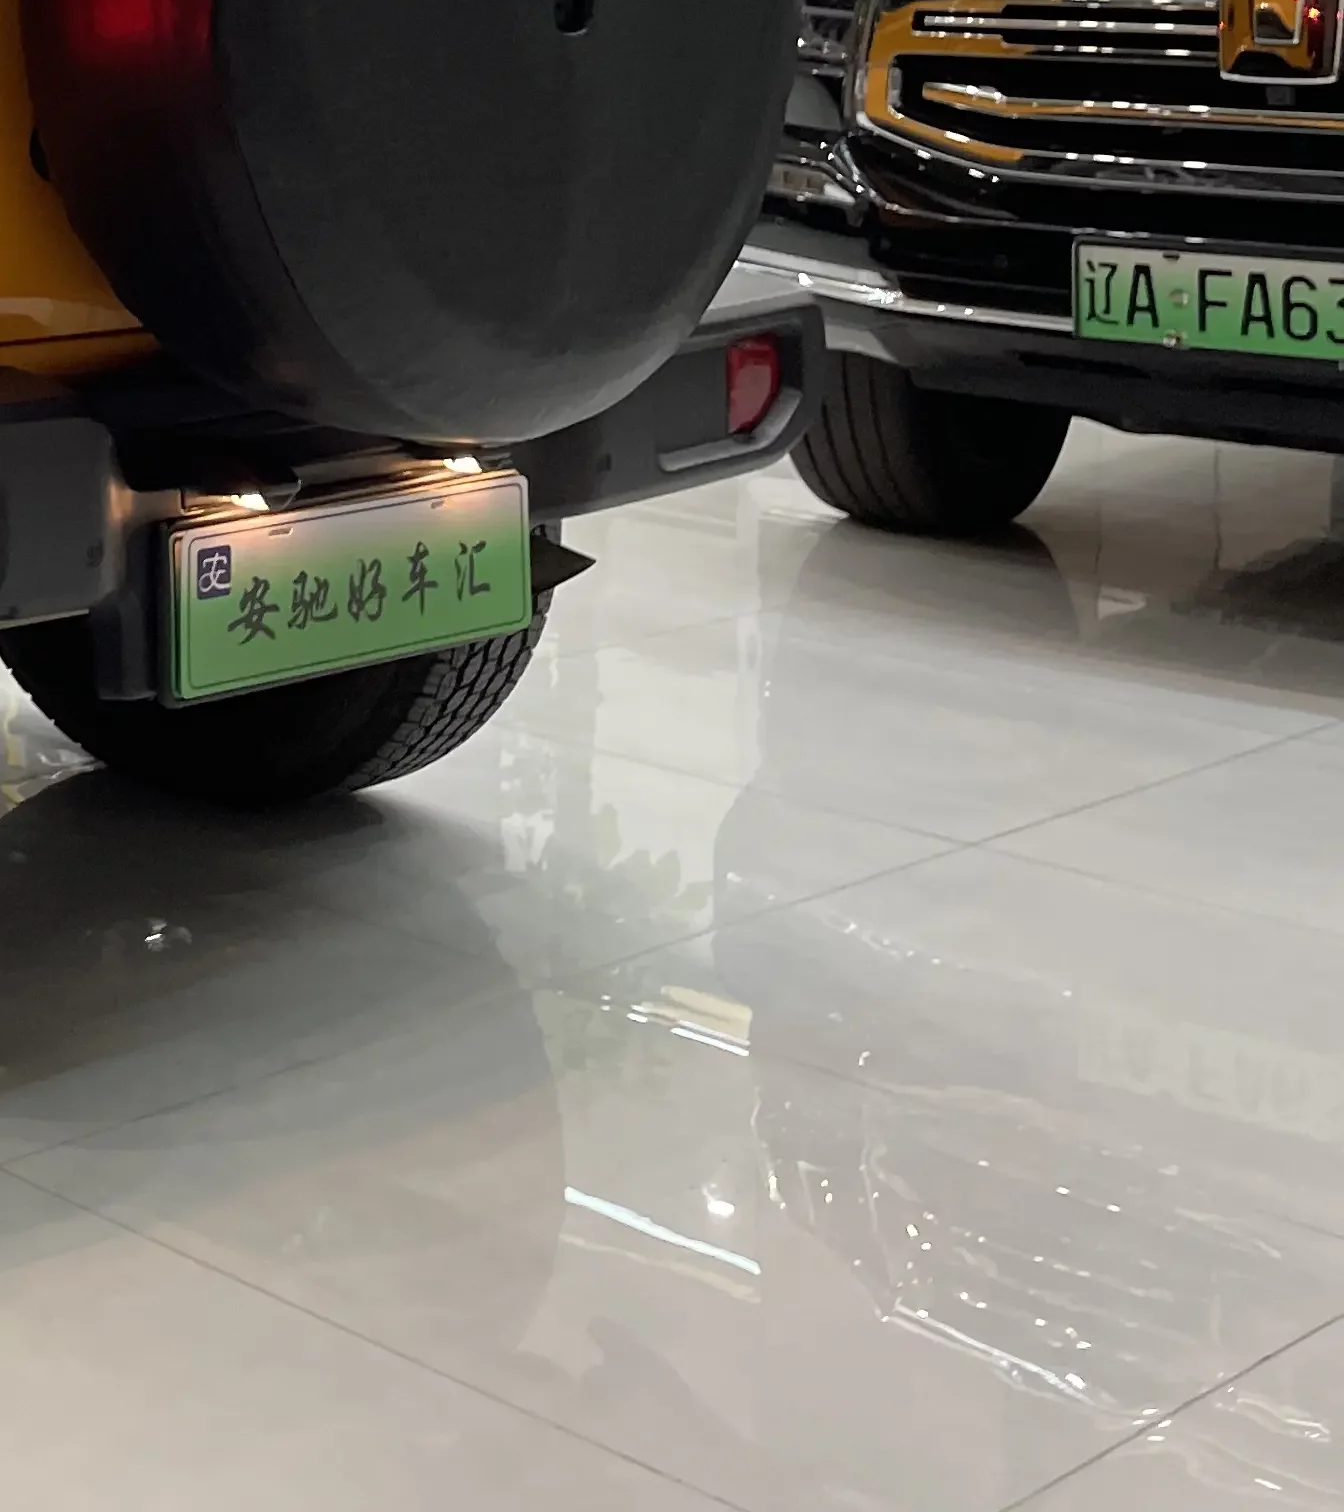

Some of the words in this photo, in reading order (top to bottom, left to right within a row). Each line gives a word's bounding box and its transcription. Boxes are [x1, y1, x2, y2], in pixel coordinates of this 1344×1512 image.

[227, 540, 492, 646] 安驰好车汇
